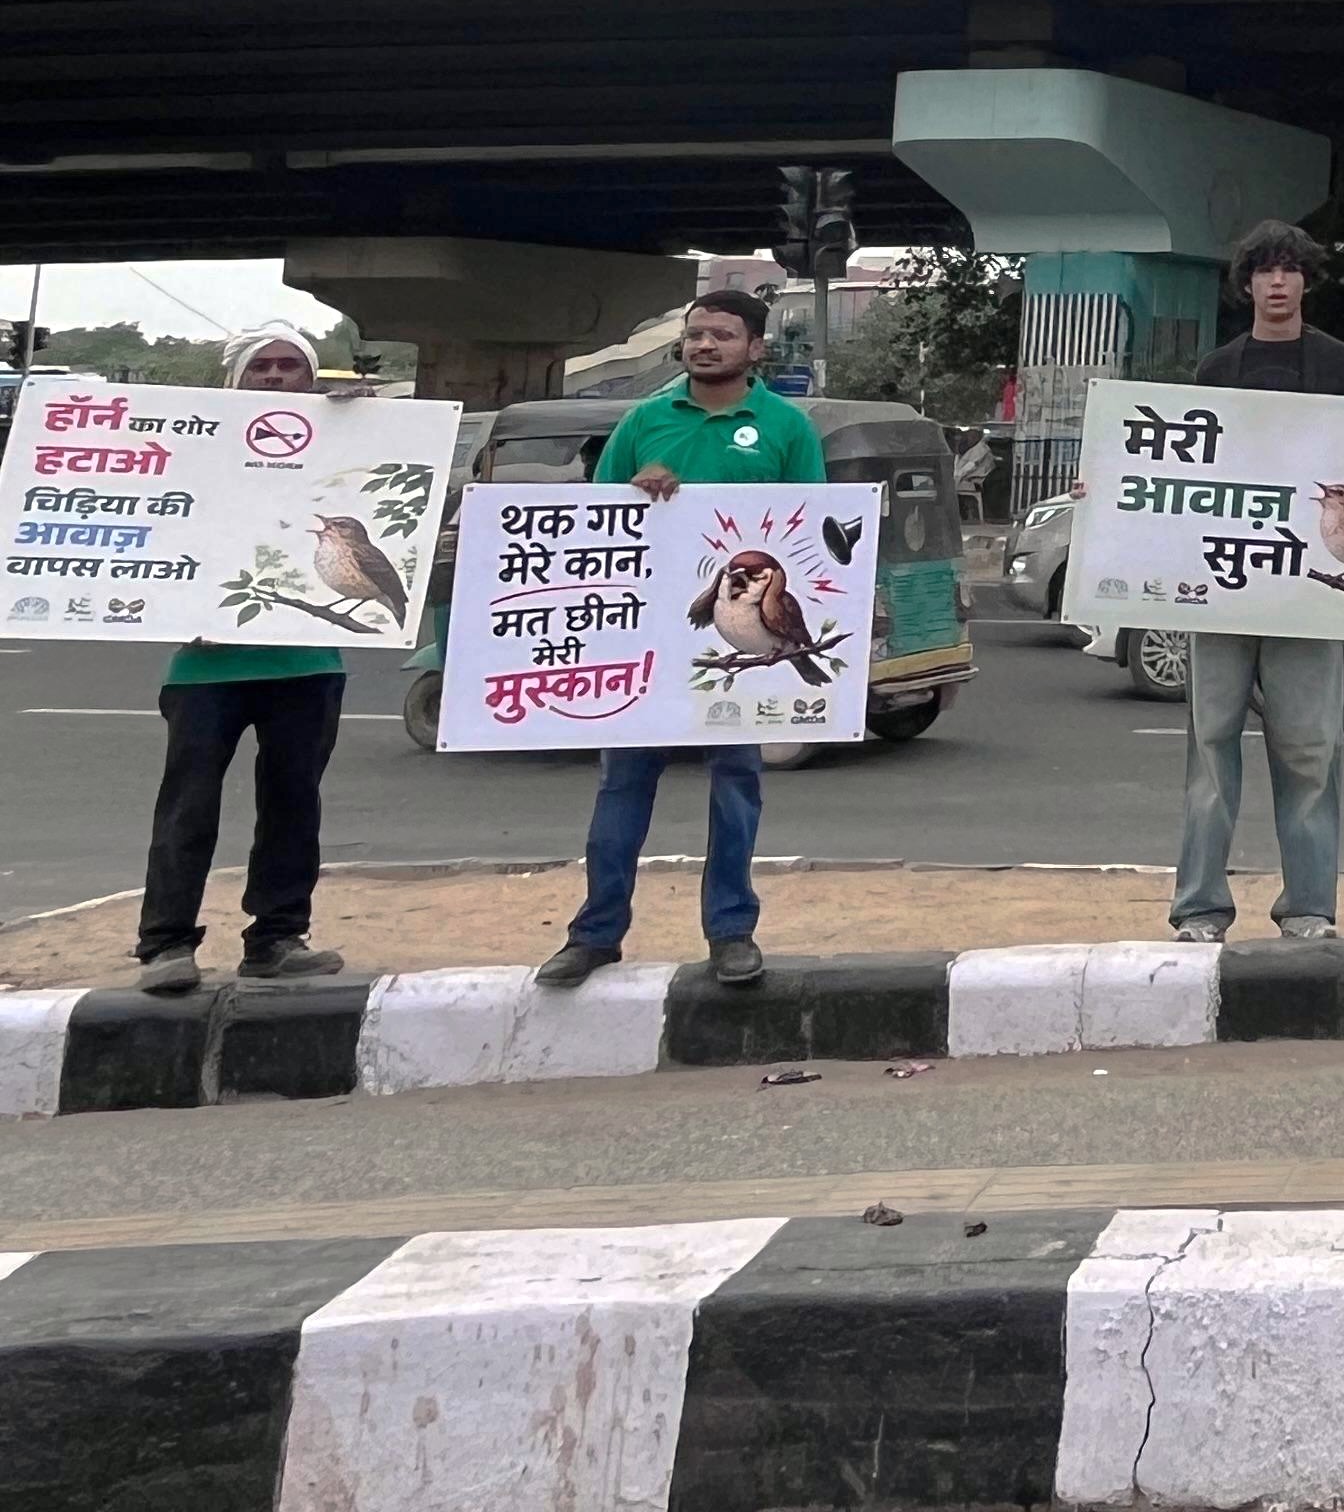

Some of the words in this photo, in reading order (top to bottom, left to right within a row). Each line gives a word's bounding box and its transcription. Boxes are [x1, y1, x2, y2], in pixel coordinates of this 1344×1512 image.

[45, 395, 128, 433] हॉर्न
[128, 416, 166, 435] का
[171, 414, 220, 437] शोर
[1123, 405, 1224, 464] मेरी
[34, 442, 172, 476] हटाओ
[22, 486, 140, 520] चिड़िया
[146, 491, 195, 517] की
[500, 503, 578, 541] थक
[587, 503, 651, 541] गए
[1116, 474, 1297, 530] आवाज़
[14, 522, 152, 553] आवाज़
[1202, 526, 1308, 590] सुनो
[6, 556, 105, 579] वापस
[110, 554, 201, 581] लाओ
[498, 542, 556, 585] मेरे
[565, 545, 653, 581] कान,
[491, 607, 556, 638] मत
[565, 592, 648, 631] छीनो
[532, 638, 586, 666] मेरी
[484, 650, 656, 725] मुस्कान!
